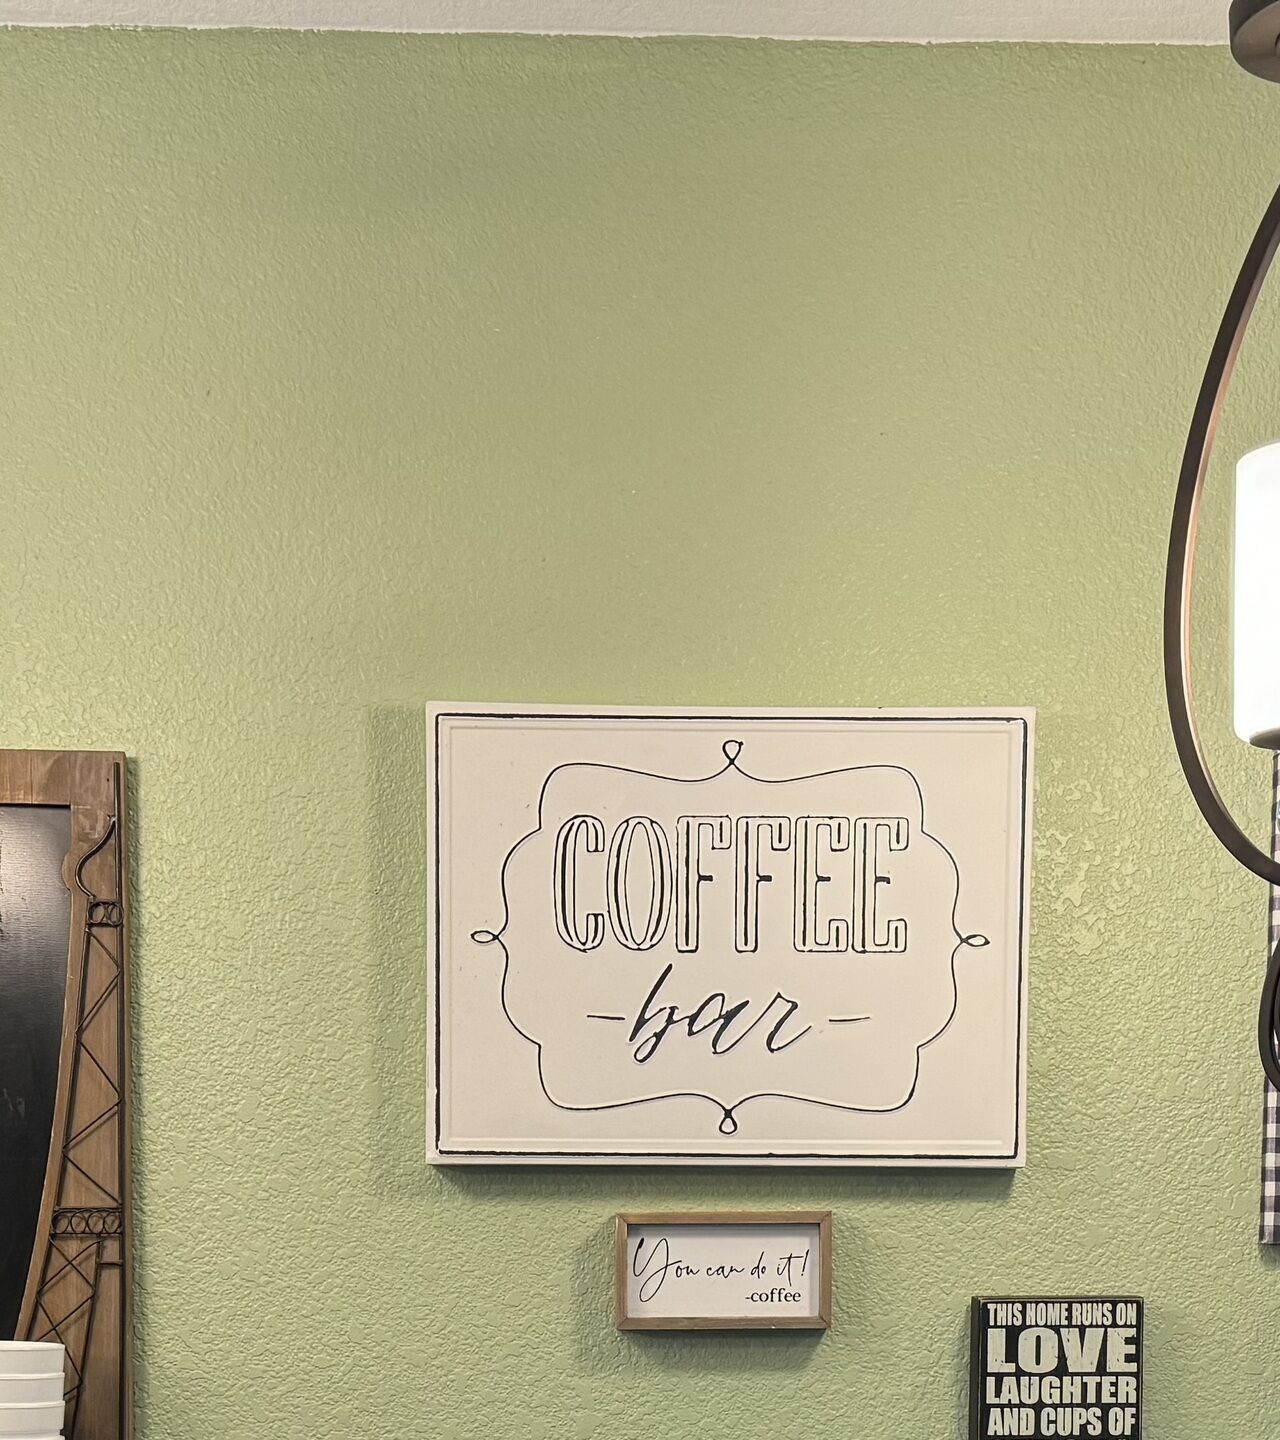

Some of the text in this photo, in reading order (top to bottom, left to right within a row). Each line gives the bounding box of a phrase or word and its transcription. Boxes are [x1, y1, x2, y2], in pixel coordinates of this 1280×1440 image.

[552, 814, 910, 953] COFFEE
[629, 963, 812, 1064] bar
[632, 1237, 810, 1303] You can do it!
[745, 1287, 802, 1303] -coffee
[987, 1303, 1137, 1326] THIS HOME RUNS ON
[986, 1327, 1138, 1374] LOVE
[985, 1375, 1138, 1405] LAUGHTER
[987, 1407, 1136, 1436] AND CUPS OF
